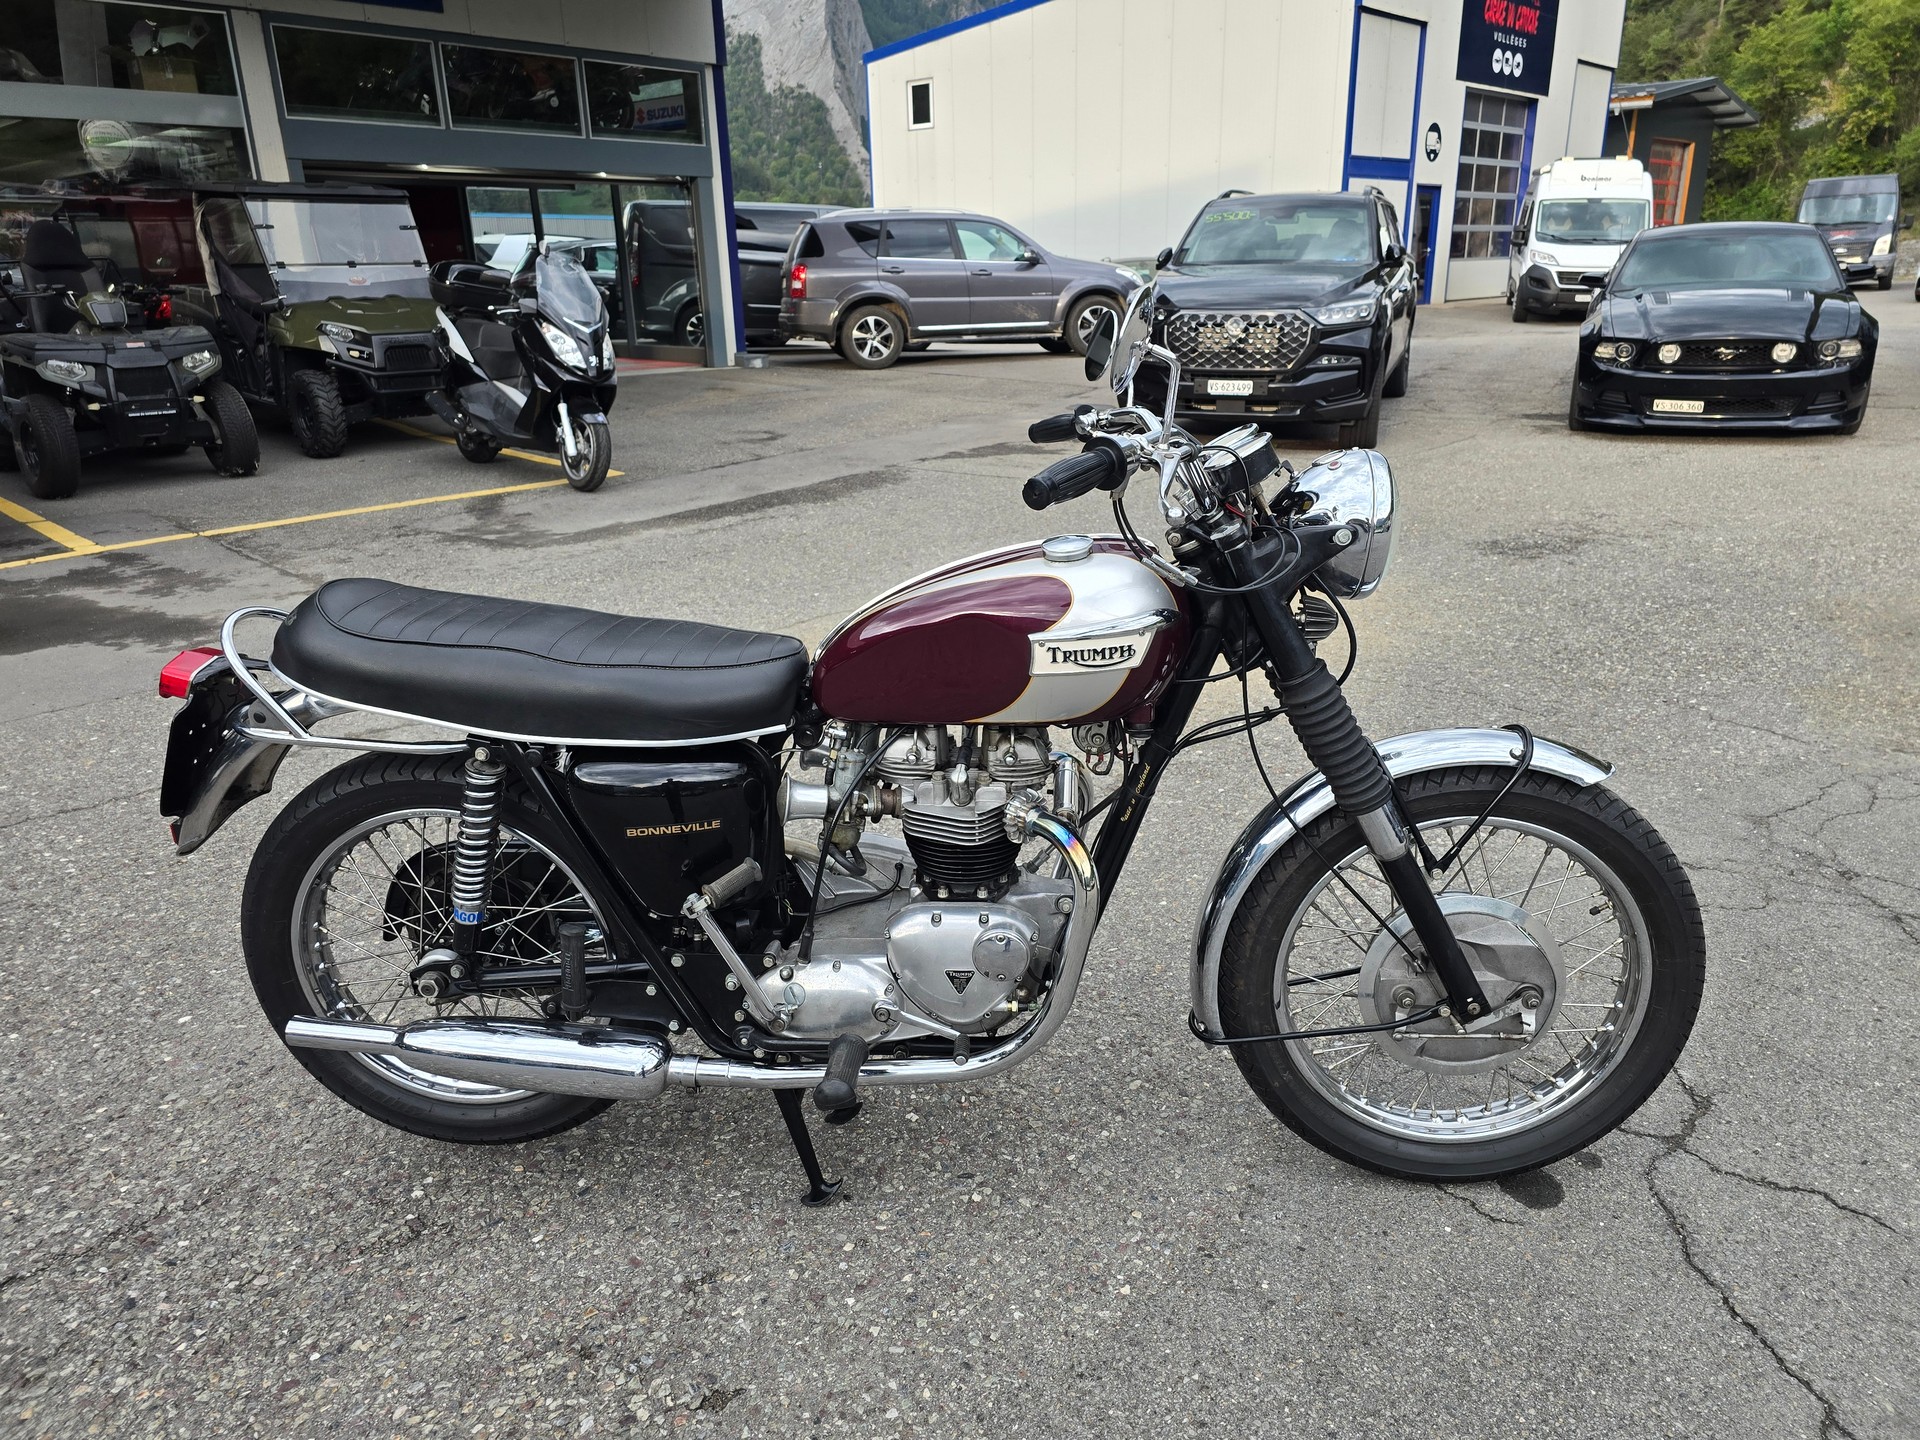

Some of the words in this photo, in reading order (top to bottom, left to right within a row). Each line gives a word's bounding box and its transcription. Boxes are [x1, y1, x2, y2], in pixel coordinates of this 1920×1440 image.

[1493, 31, 1527, 48] VOLLÈGES
[647, 104, 684, 121] SUZUKI
[1046, 643, 1136, 667] TRIUMPH
[626, 820, 721, 837] BONNEVILLE
